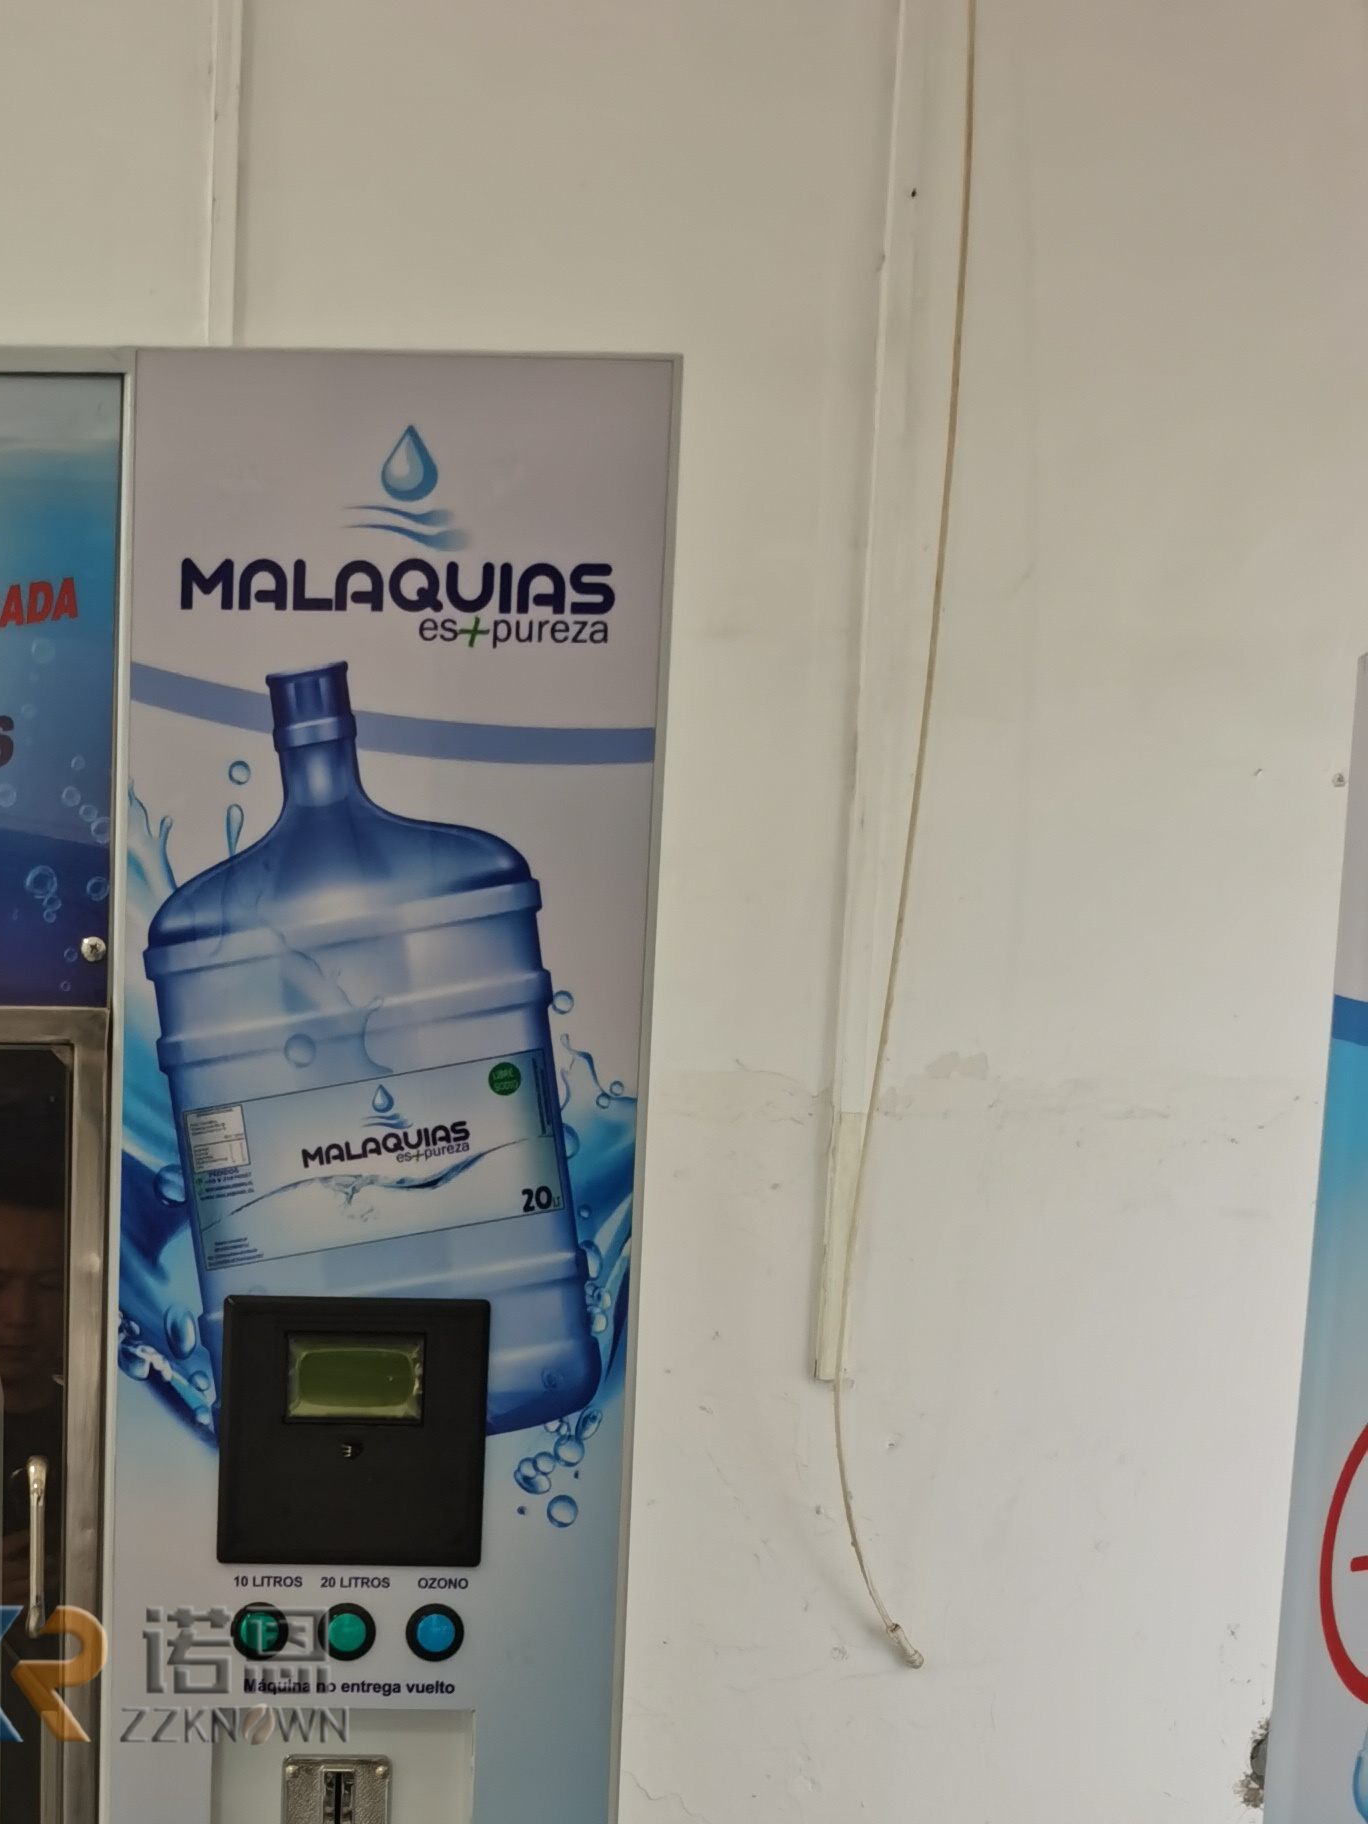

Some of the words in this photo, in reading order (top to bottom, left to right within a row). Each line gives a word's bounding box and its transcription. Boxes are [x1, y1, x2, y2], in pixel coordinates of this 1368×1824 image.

[181, 558, 615, 615] MALAQUIAS
[302, 1121, 470, 1168] MALAQUIAS
[522, 1186, 552, 1213] 20
[234, 1576, 248, 1587] 10
[253, 1576, 302, 1587] LITROS
[321, 1577, 336, 1588] 20
[340, 1577, 390, 1588] LITROS
[418, 1578, 468, 1589] OZONO
[244, 1673, 310, 1695] Máquina
[316, 1683, 336, 1693] no
[341, 1681, 401, 1696] entrega
[406, 1681, 455, 1694] vuelto
